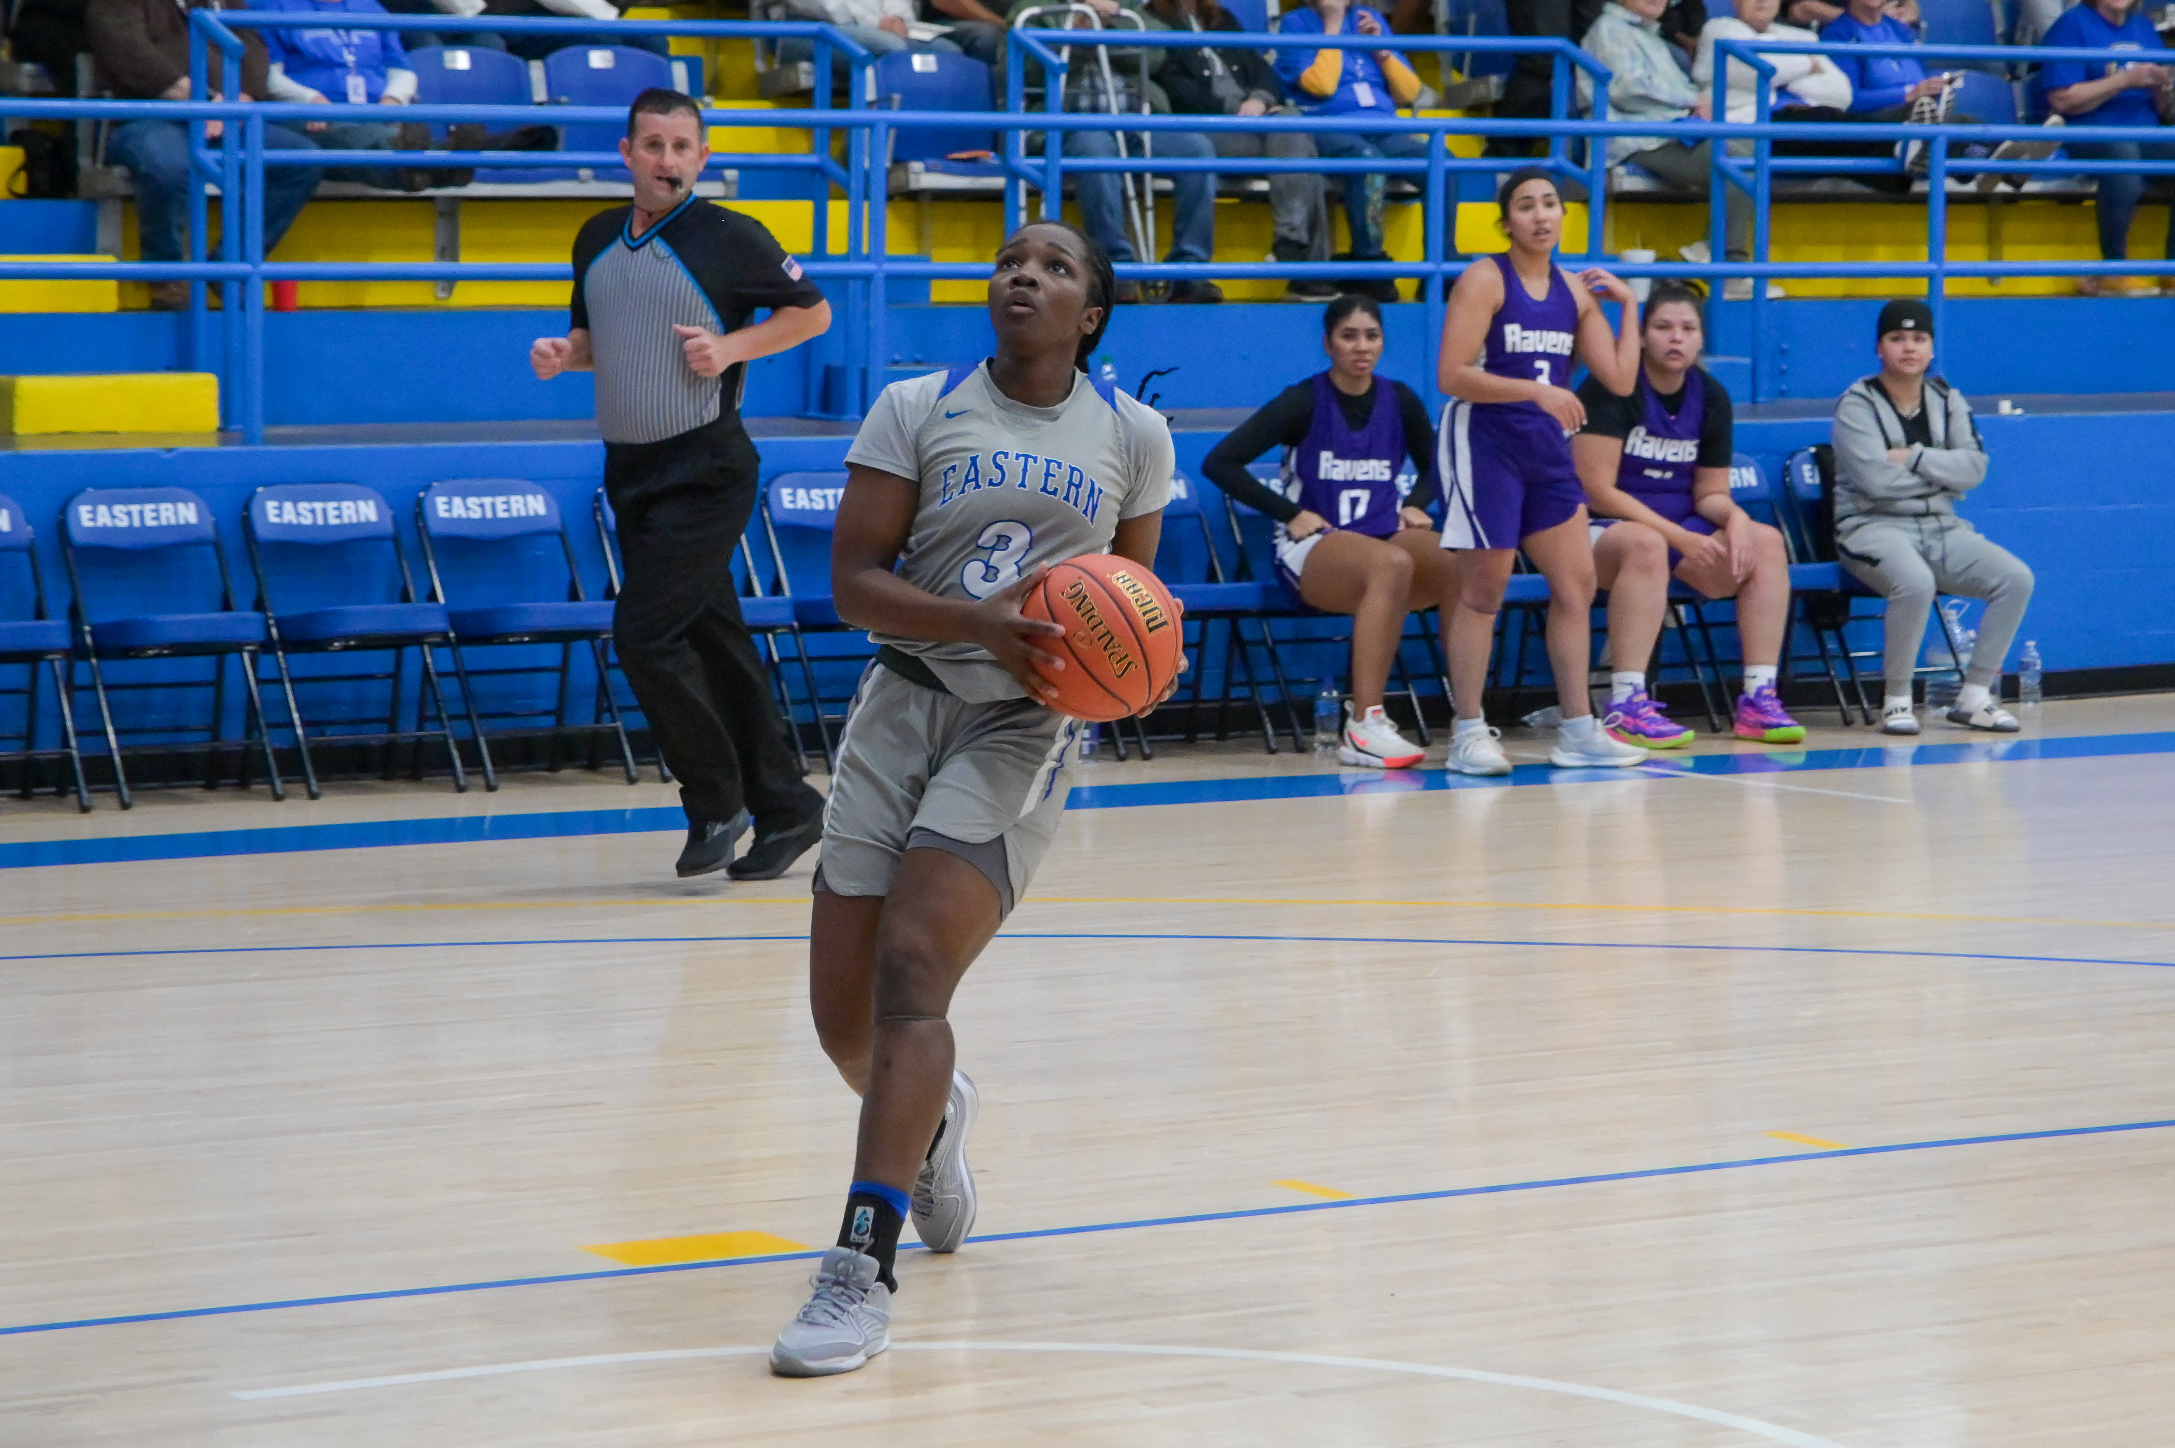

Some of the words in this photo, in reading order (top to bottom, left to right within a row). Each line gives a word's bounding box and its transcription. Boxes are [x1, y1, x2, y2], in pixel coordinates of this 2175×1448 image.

[1503, 322, 1574, 356] Ravens
[1624, 425, 1698, 462] Ravens
[1318, 450, 1391, 481] Ravens
[780, 487, 845, 511] EAST
[937, 449, 1104, 527] EASTERN
[77, 502, 198, 528] EASTERN
[265, 500, 378, 525] EASTERN
[434, 494, 547, 519] EASTERN
[960, 519, 1033, 601] 3
[1060, 579, 1139, 679] SPALDING
